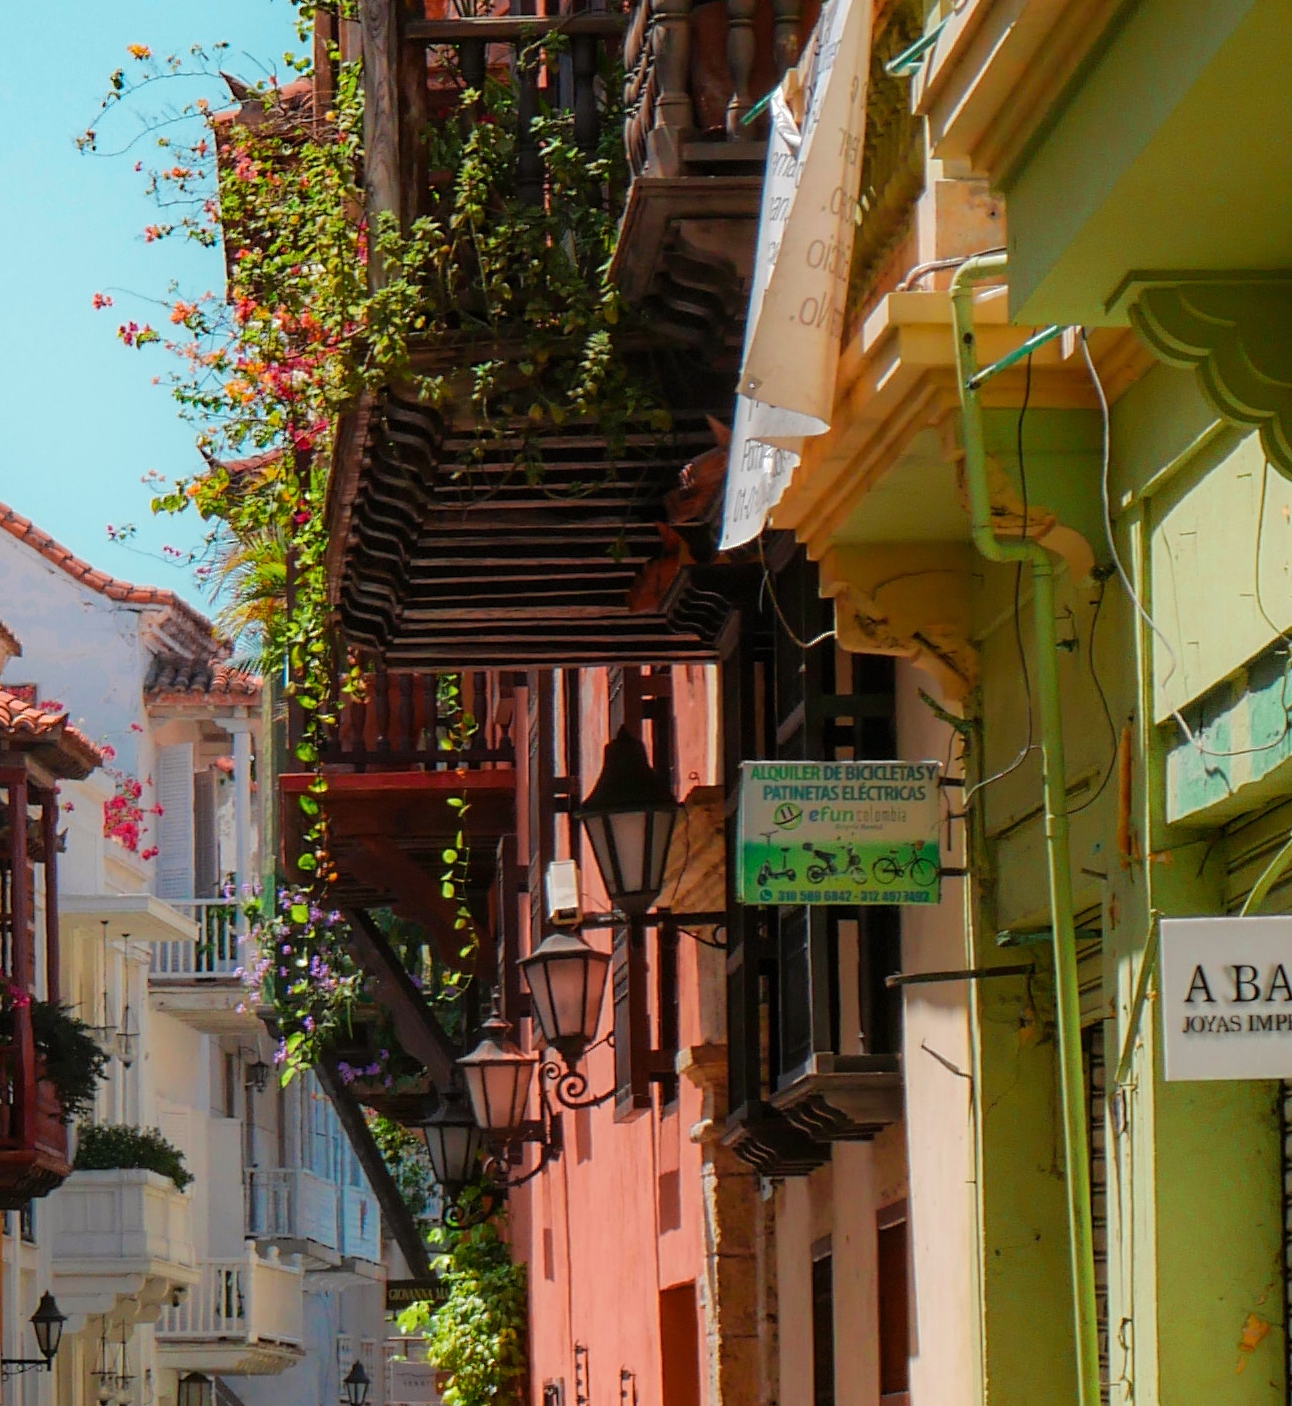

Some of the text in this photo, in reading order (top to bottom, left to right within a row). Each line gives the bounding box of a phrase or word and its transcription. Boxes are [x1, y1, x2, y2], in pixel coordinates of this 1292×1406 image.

[751, 766, 937, 782] ALQUILER DE BICICLETAS Y
[763, 782, 926, 801] PATINETAS ELÉCTRICAS
[1184, 964, 1216, 1002] A
[1182, 1016, 1242, 1033] JOYAS
